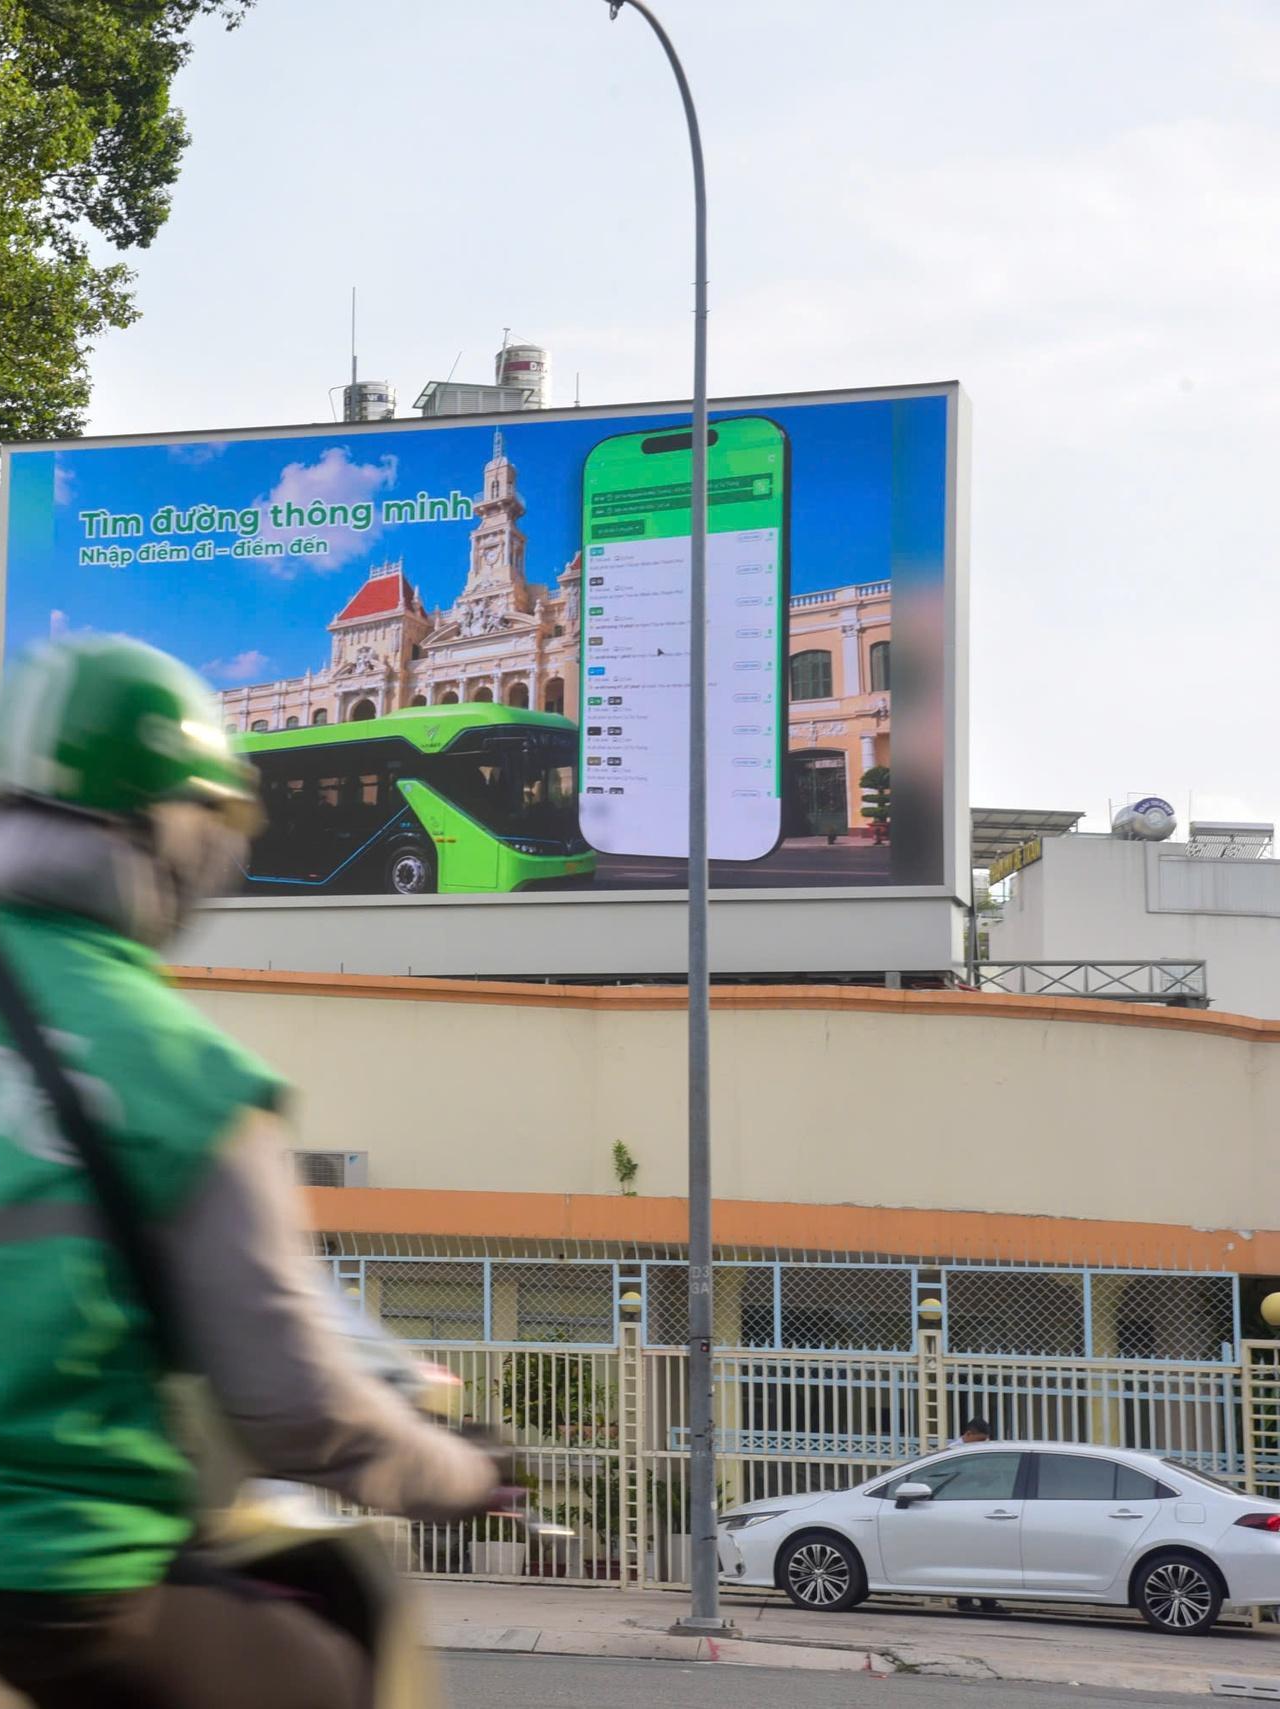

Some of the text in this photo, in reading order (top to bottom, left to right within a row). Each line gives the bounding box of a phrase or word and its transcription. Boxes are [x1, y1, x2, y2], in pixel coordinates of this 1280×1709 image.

[80, 491, 474, 537] Tìm đường thông minh
[80, 546, 133, 568] Nhập
[138, 542, 188, 563] điểm
[192, 539, 213, 560] đi
[232, 537, 284, 559] điểm
[288, 535, 329, 556] đến
